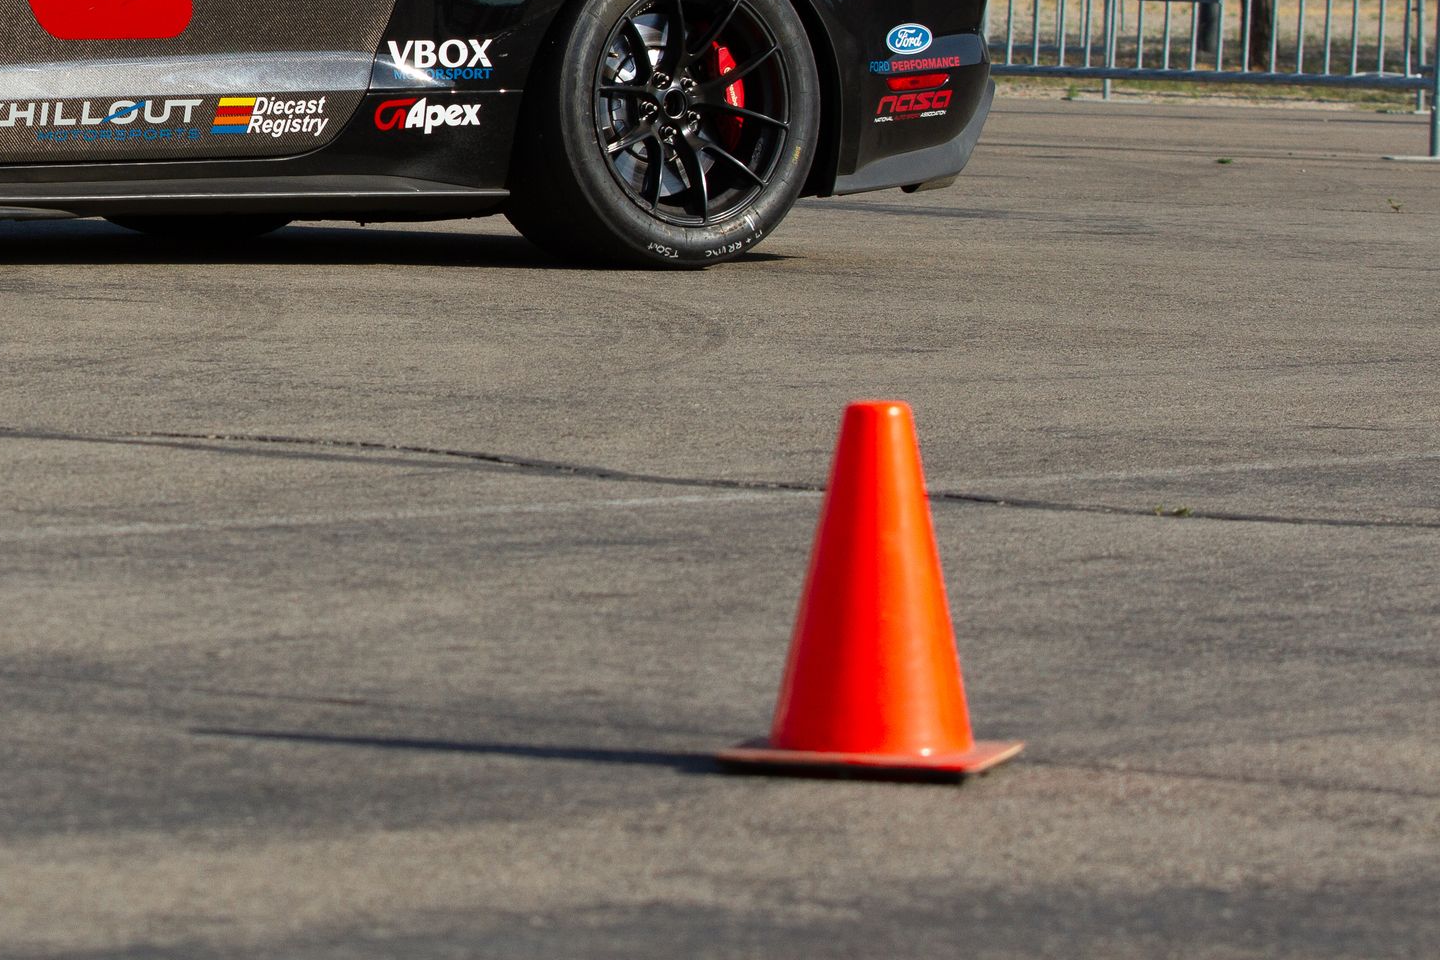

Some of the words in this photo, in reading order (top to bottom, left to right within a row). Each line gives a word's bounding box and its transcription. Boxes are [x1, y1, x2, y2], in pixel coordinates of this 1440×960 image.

[895, 28, 923, 48] Ford
[387, 39, 493, 68] VBOX
[394, 68, 493, 80] MORSPORT
[869, 60, 891, 73] FORD
[891, 56, 960, 73] PERFORMANCE
[252, 96, 326, 115] Diecast
[876, 89, 953, 115] nasa
[37, 127, 201, 141] MOTORSPORTS
[247, 115, 329, 137] Registry
